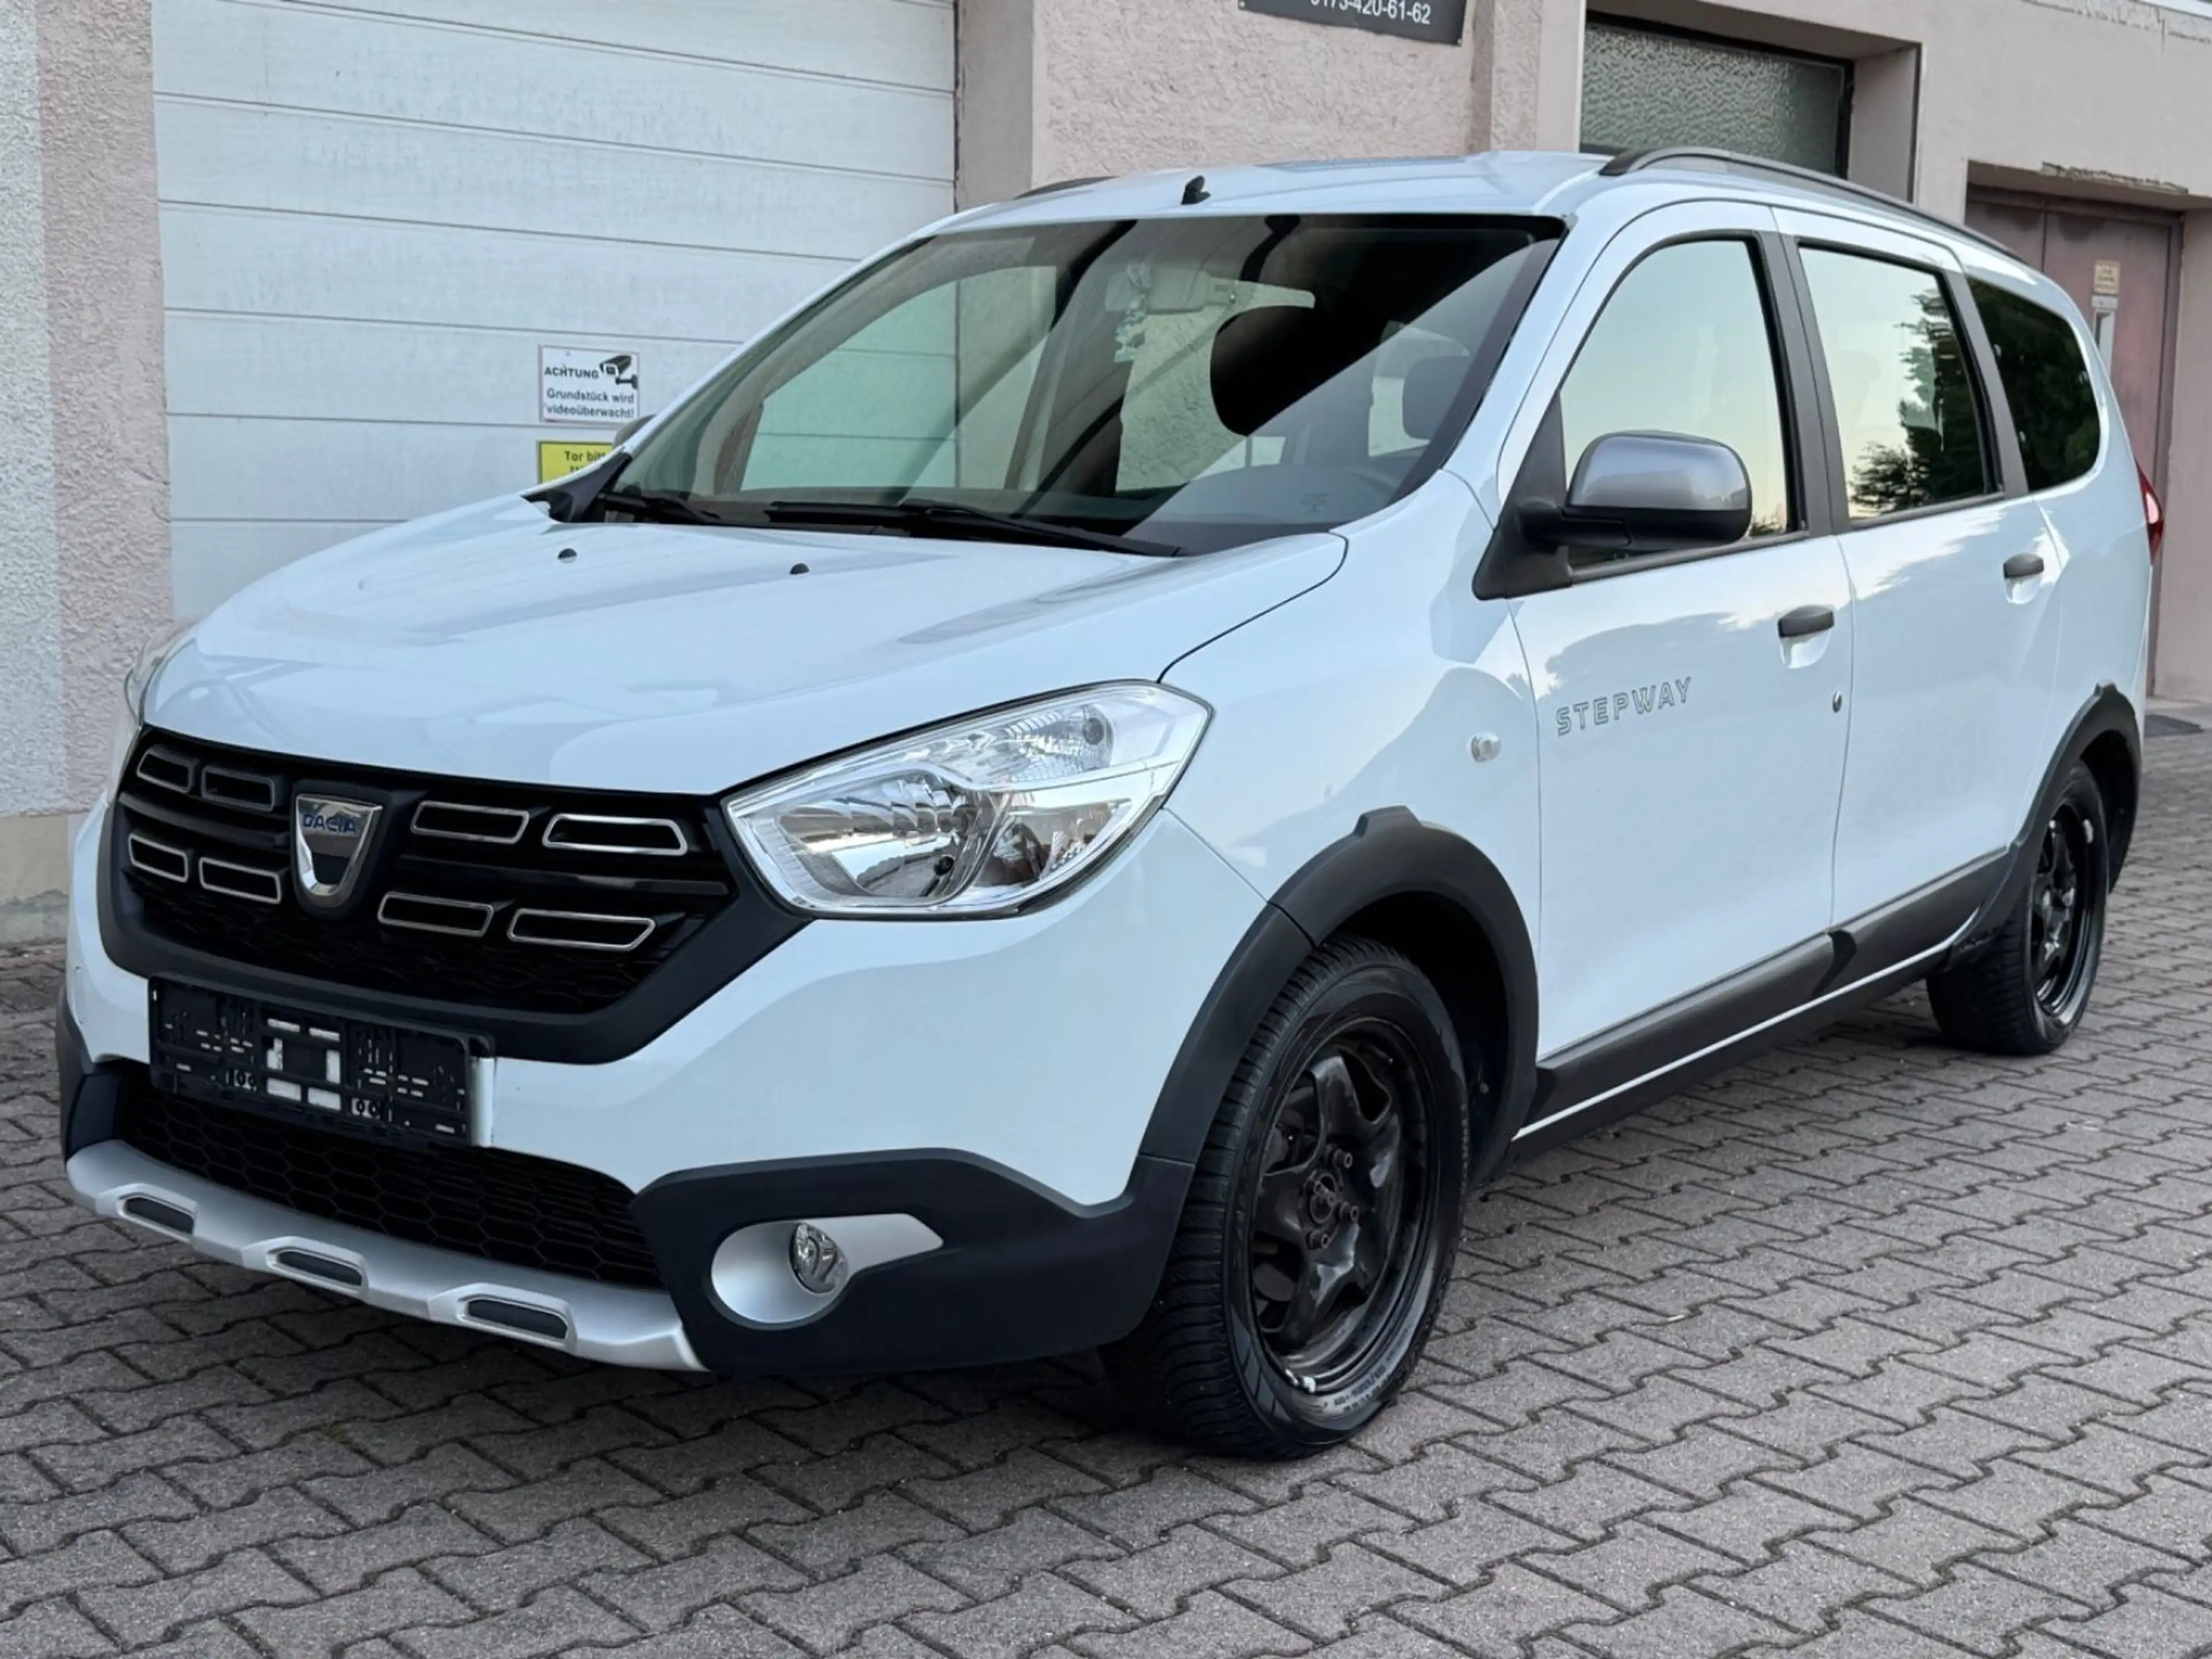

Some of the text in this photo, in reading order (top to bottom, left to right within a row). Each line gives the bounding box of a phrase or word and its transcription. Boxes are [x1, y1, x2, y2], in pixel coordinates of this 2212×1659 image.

[544, 366, 600, 379] ACHTUNG
[547, 387, 634, 404] Grundstück wird
[565, 450, 583, 463] Tor
[1556, 676, 1691, 737] STEPWAY
[302, 813, 356, 833] DACIA
